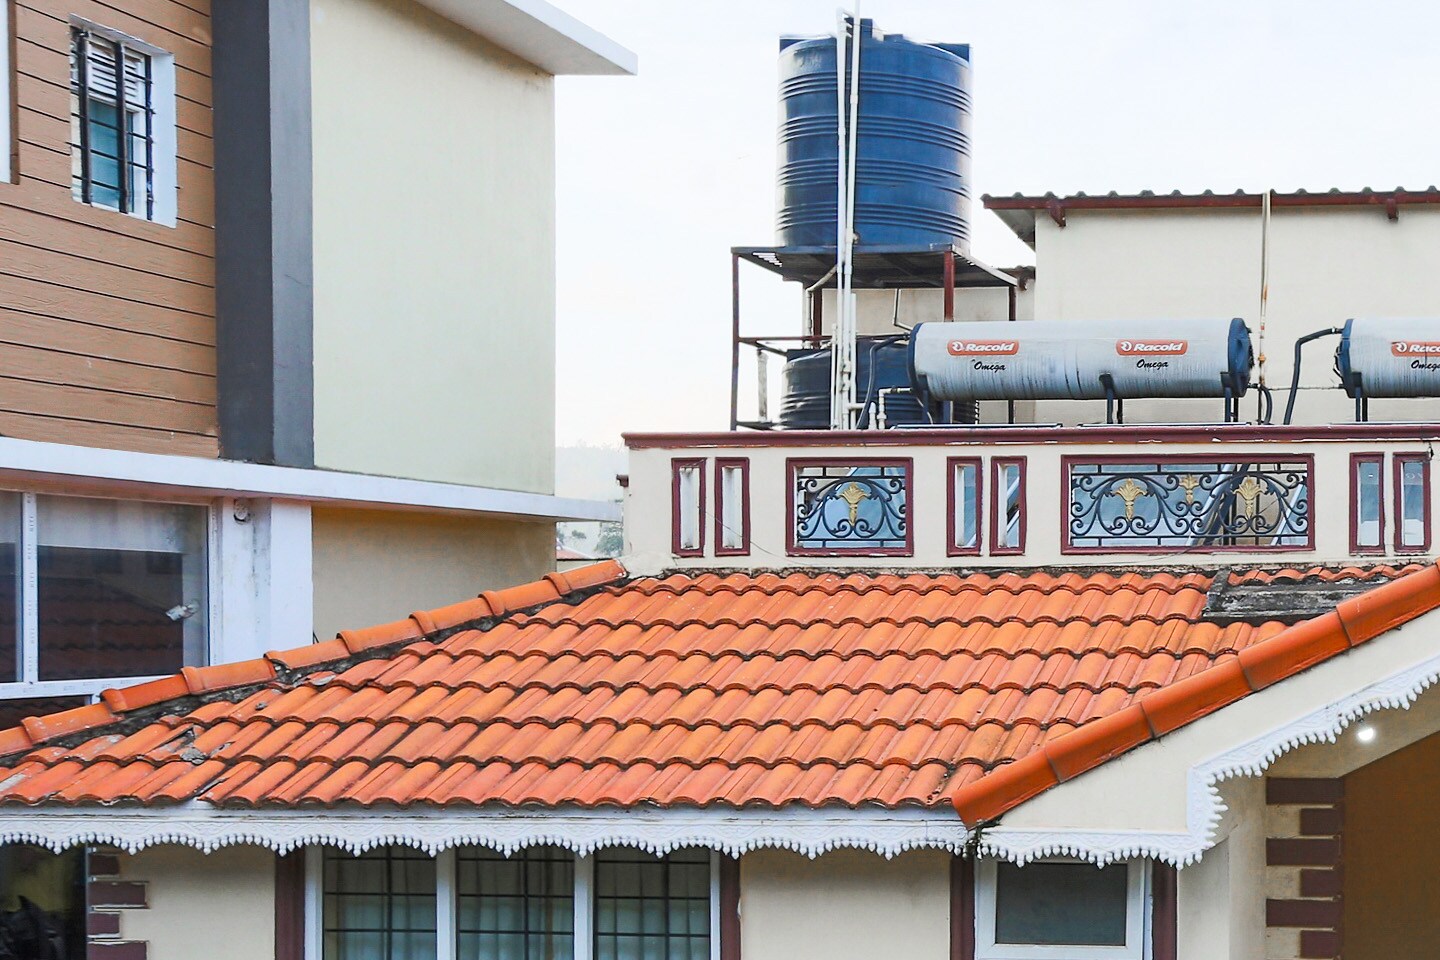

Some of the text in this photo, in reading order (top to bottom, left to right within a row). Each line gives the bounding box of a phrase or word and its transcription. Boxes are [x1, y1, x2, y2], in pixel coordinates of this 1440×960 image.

[965, 342, 1015, 353] Racold
[1133, 342, 1183, 353] Racold
[973, 360, 1006, 371] Omega
[1136, 359, 1169, 370] Omega
